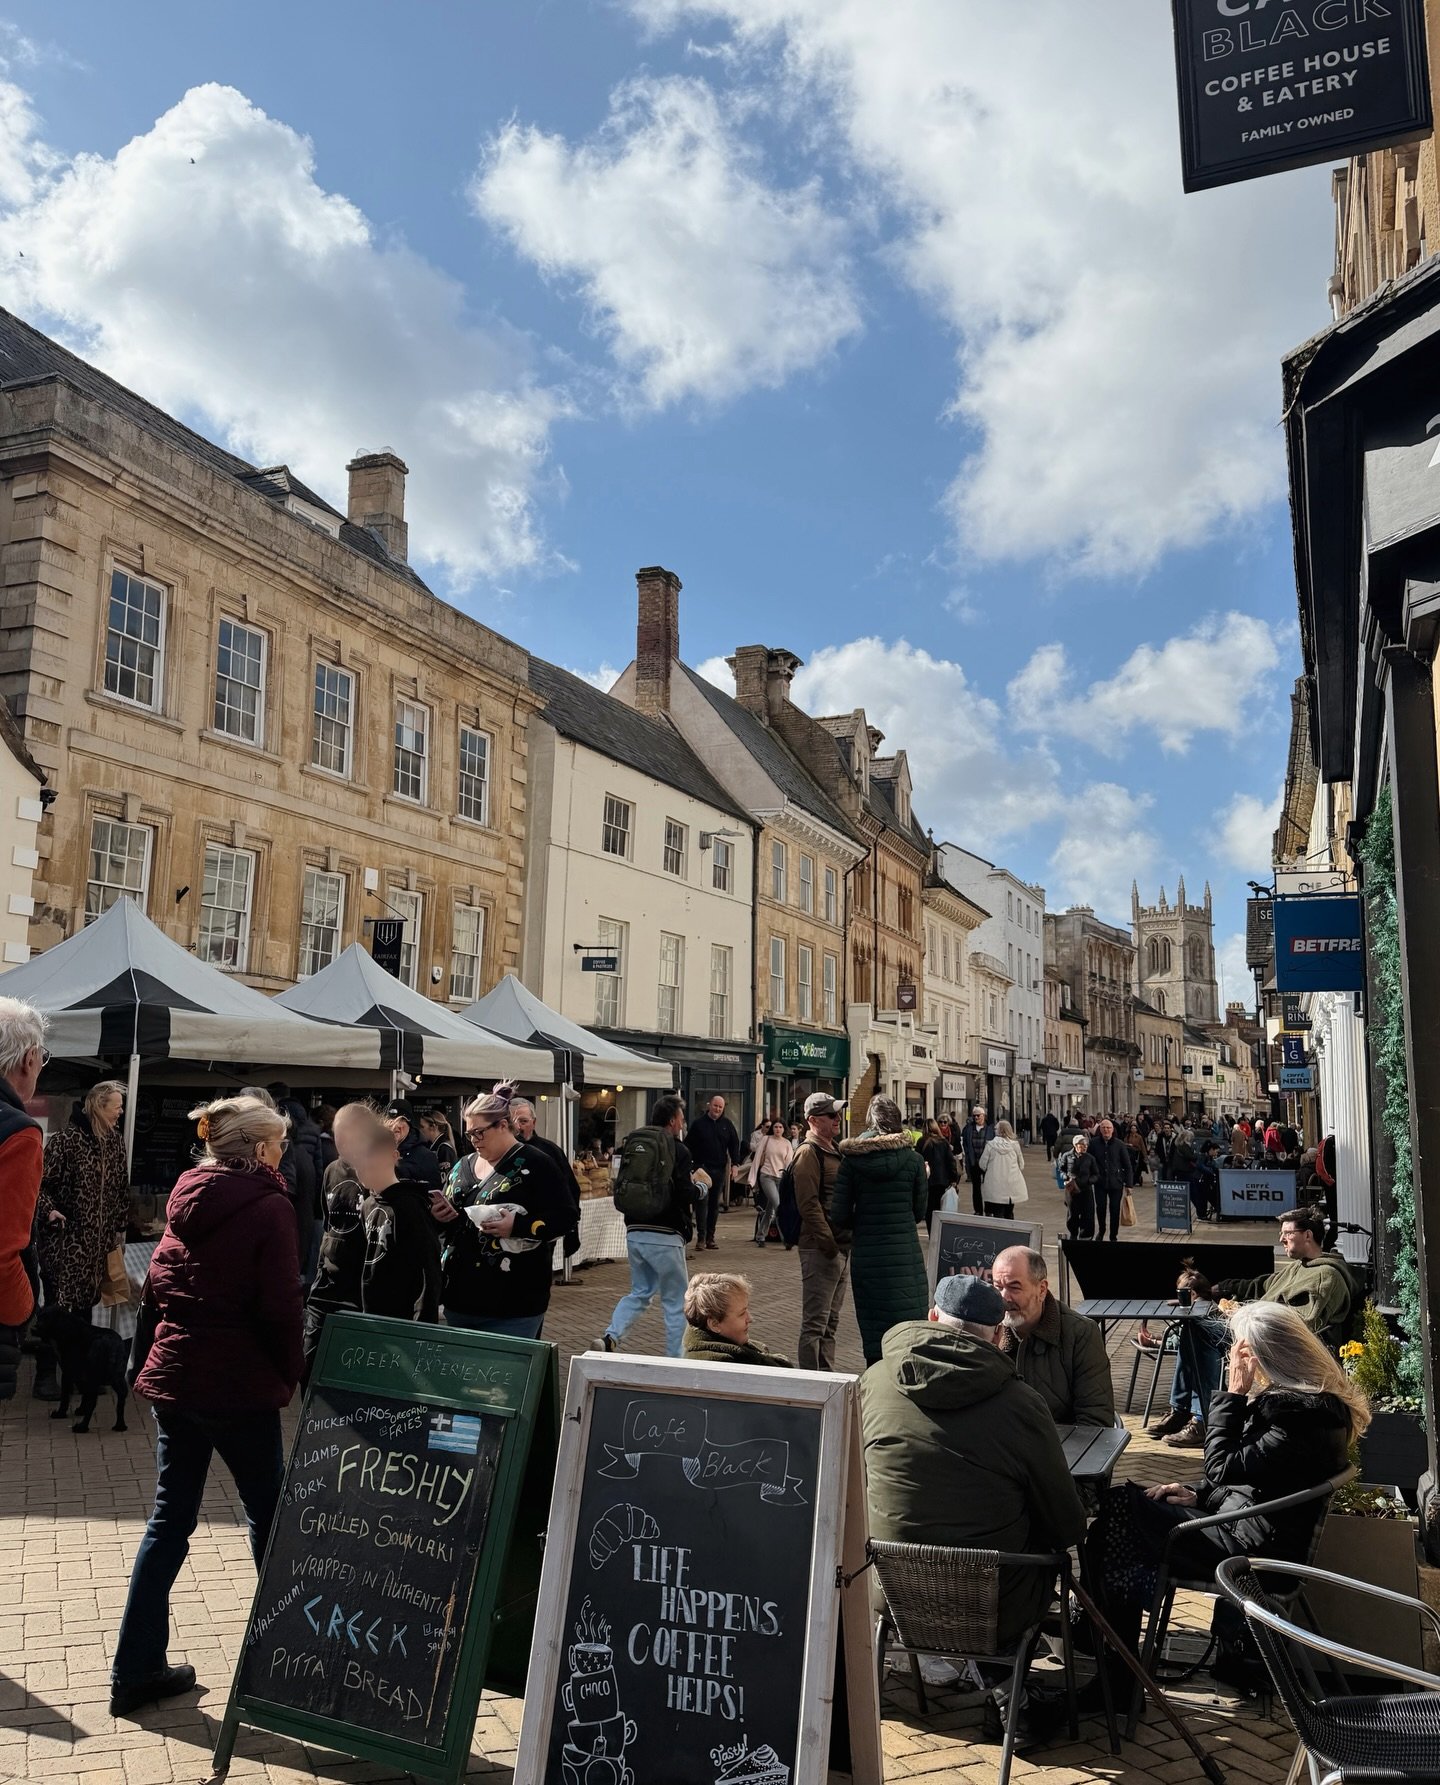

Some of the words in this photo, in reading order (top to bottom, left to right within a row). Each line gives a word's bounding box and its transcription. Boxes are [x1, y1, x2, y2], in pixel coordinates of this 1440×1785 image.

[1203, 0, 1391, 61] BLACK
[1205, 62, 1294, 96] COFFEE
[1304, 38, 1390, 73] HOUSE
[1237, 96, 1253, 112] &
[1263, 70, 1358, 106] EATERY
[1241, 121, 1293, 143] FAMILY
[1297, 108, 1355, 129] OWNED
[944, 1082, 953, 1090] NEW
[1232, 1190, 1284, 1201] NERO
[341, 1346, 401, 1369] GREEK
[416, 1340, 445, 1358] THE
[414, 1358, 513, 1385] EXPERIENCE
[306, 1414, 354, 1435] CHICKEN
[355, 1407, 391, 1423] GYROS
[389, 1416, 423, 1440] FRIES
[390, 1405, 428, 1424] OREGANO
[633, 1410, 686, 1447] Café
[702, 1450, 772, 1479] Black
[293, 1476, 327, 1502] PORK
[337, 1444, 474, 1526] FRESHLY
[300, 1506, 370, 1539] GRILLED
[292, 1554, 356, 1587] WRAPPED
[361, 1570, 379, 1588] IN
[632, 1544, 691, 1589] LIFE
[253, 1580, 305, 1639] HALLOUMI
[303, 1594, 407, 1659] GREEK
[628, 1622, 737, 1679] COFFEE
[269, 1647, 325, 1679] PITTA
[343, 1661, 423, 1721] BREAD
[667, 1673, 746, 1723] HELPS!
[710, 1733, 749, 1772] Tasty!
